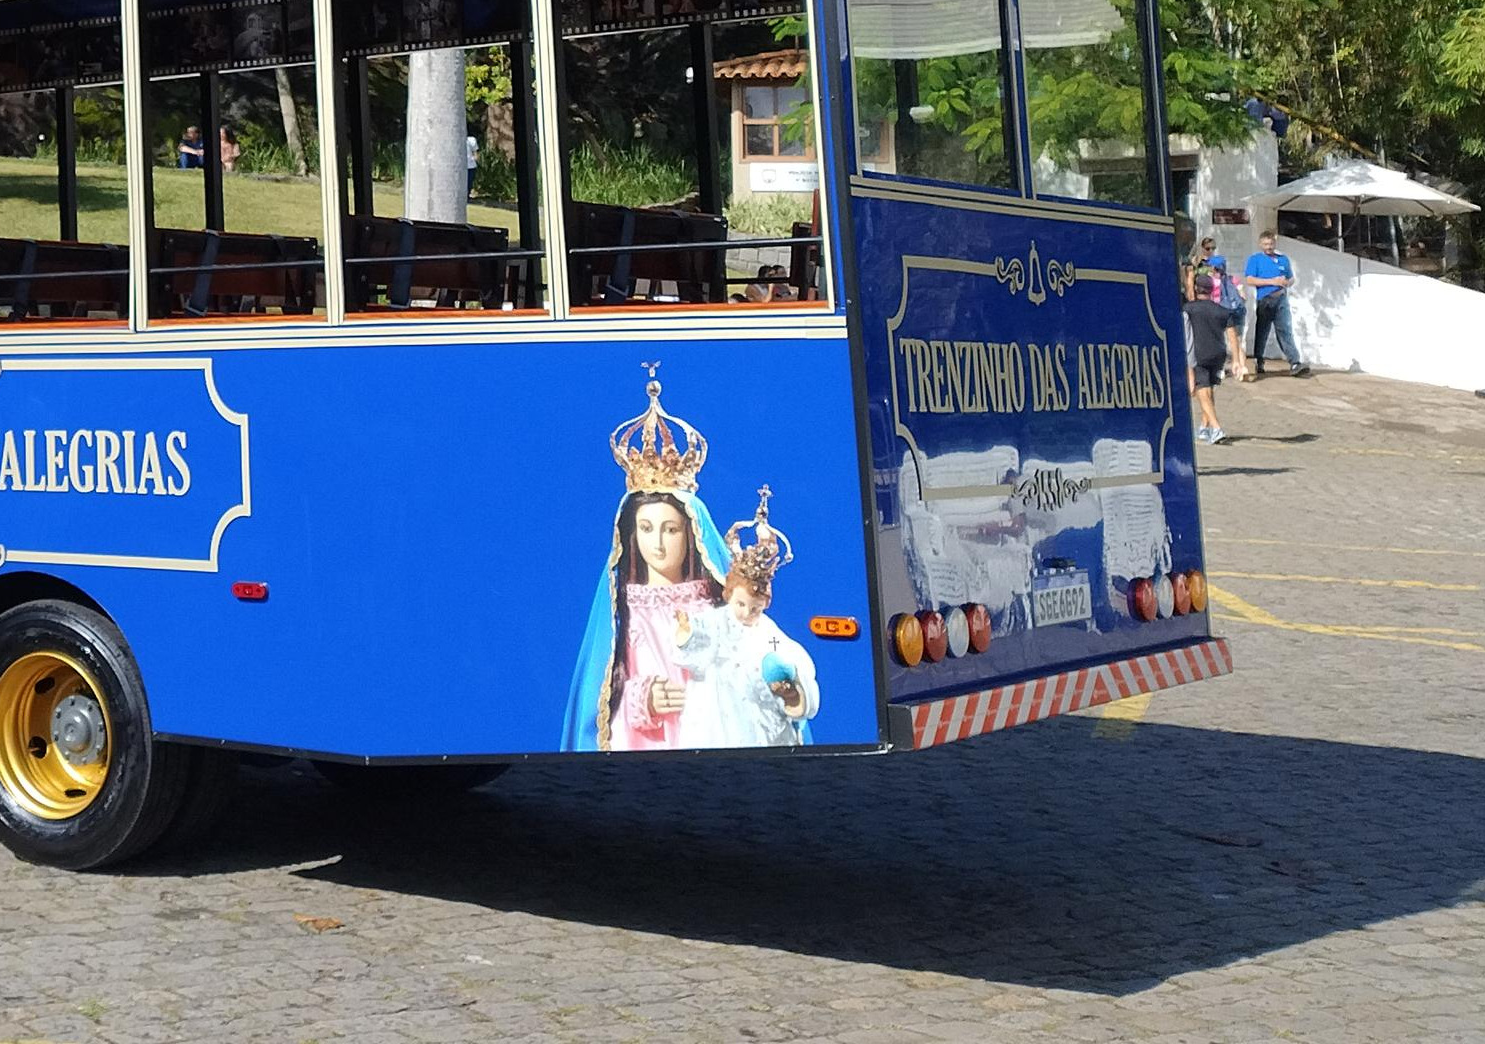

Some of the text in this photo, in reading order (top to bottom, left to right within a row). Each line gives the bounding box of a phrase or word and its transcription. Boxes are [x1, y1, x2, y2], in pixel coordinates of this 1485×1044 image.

[899, 337, 1165, 414] TRENZINHO DAS ALEGRIAS
